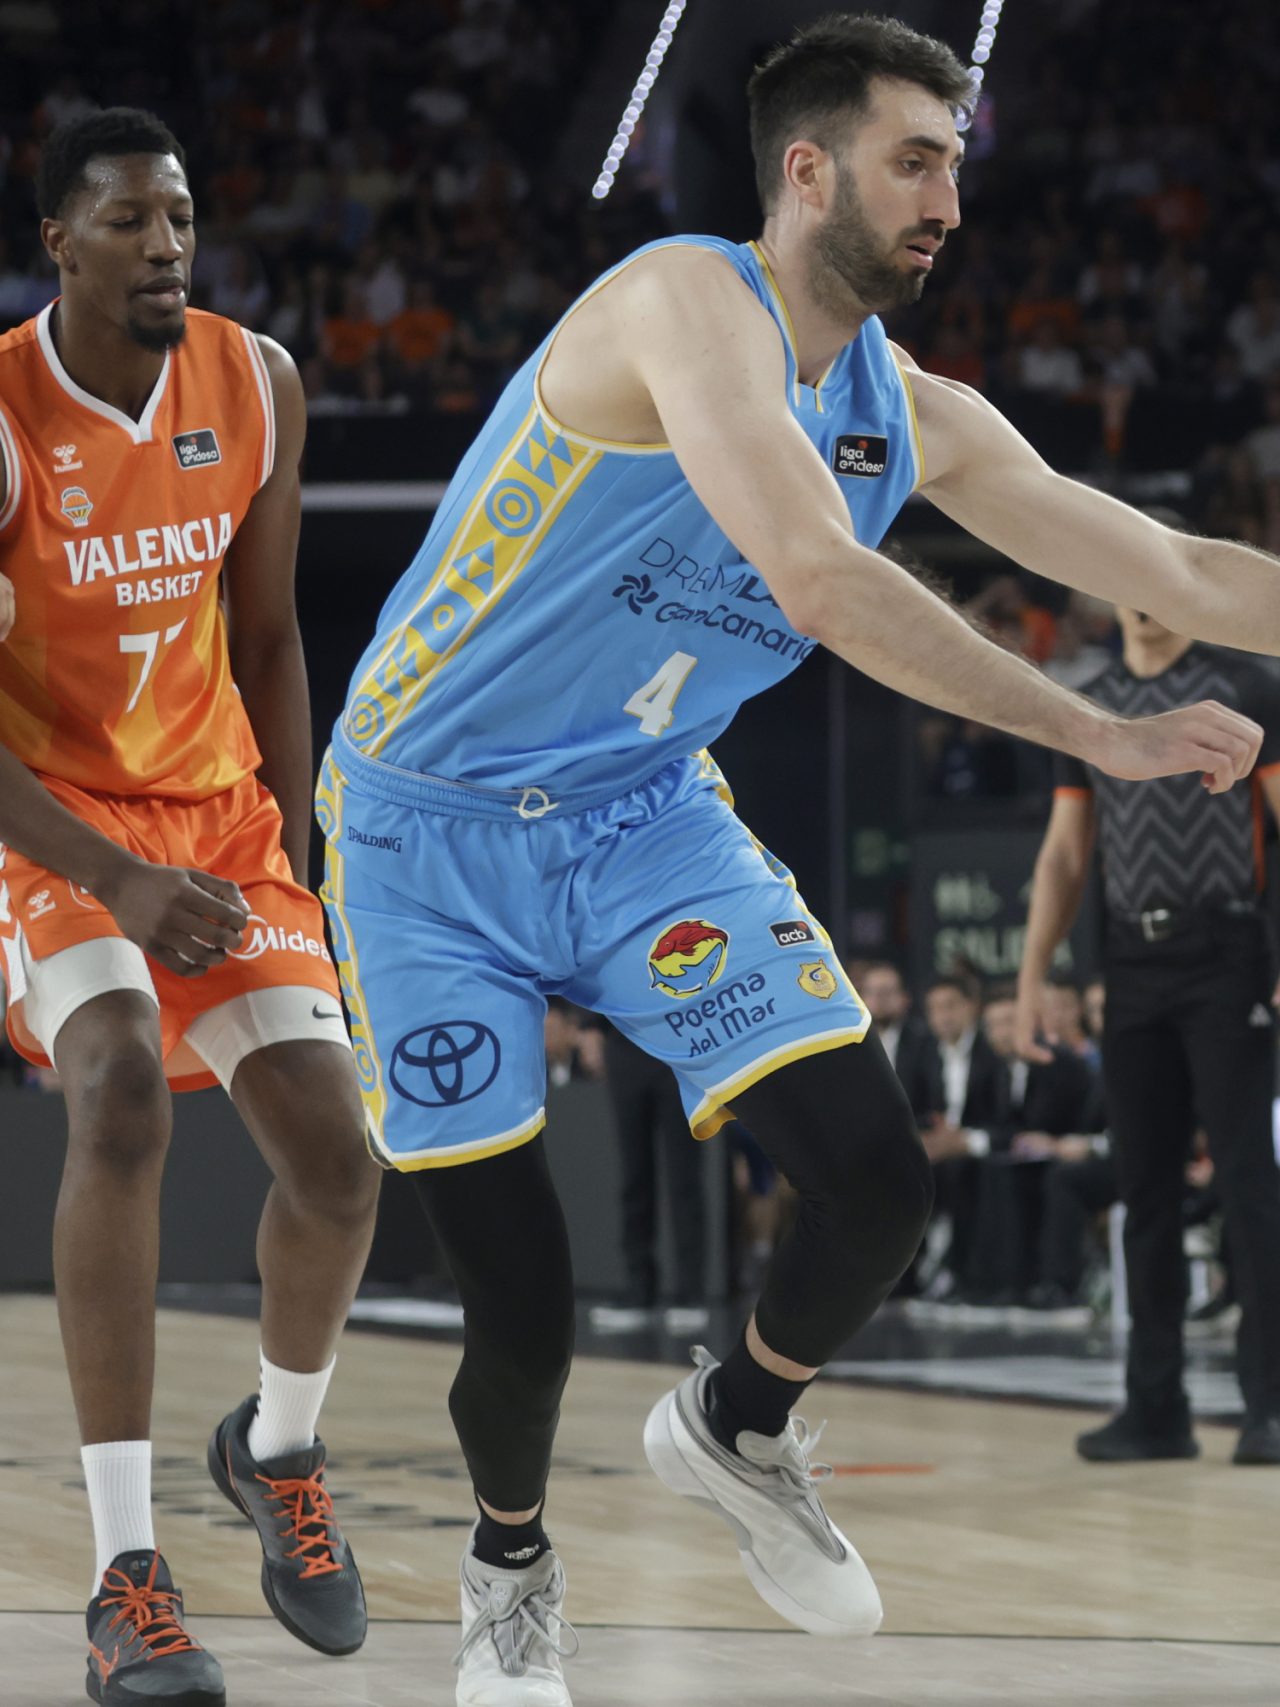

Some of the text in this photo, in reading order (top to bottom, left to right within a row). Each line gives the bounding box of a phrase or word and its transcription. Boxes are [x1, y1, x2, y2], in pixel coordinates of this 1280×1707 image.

[839, 460, 884, 473] endesa
[840, 445, 865, 460] liga
[63, 512, 233, 586] VALENCIA
[115, 571, 203, 606] BASKET
[623, 650, 698, 737] 4
[243, 926, 332, 963] Midea
[778, 929, 808, 944] acb
[664, 972, 766, 1037] Poema
[688, 998, 776, 1058] del Mar
